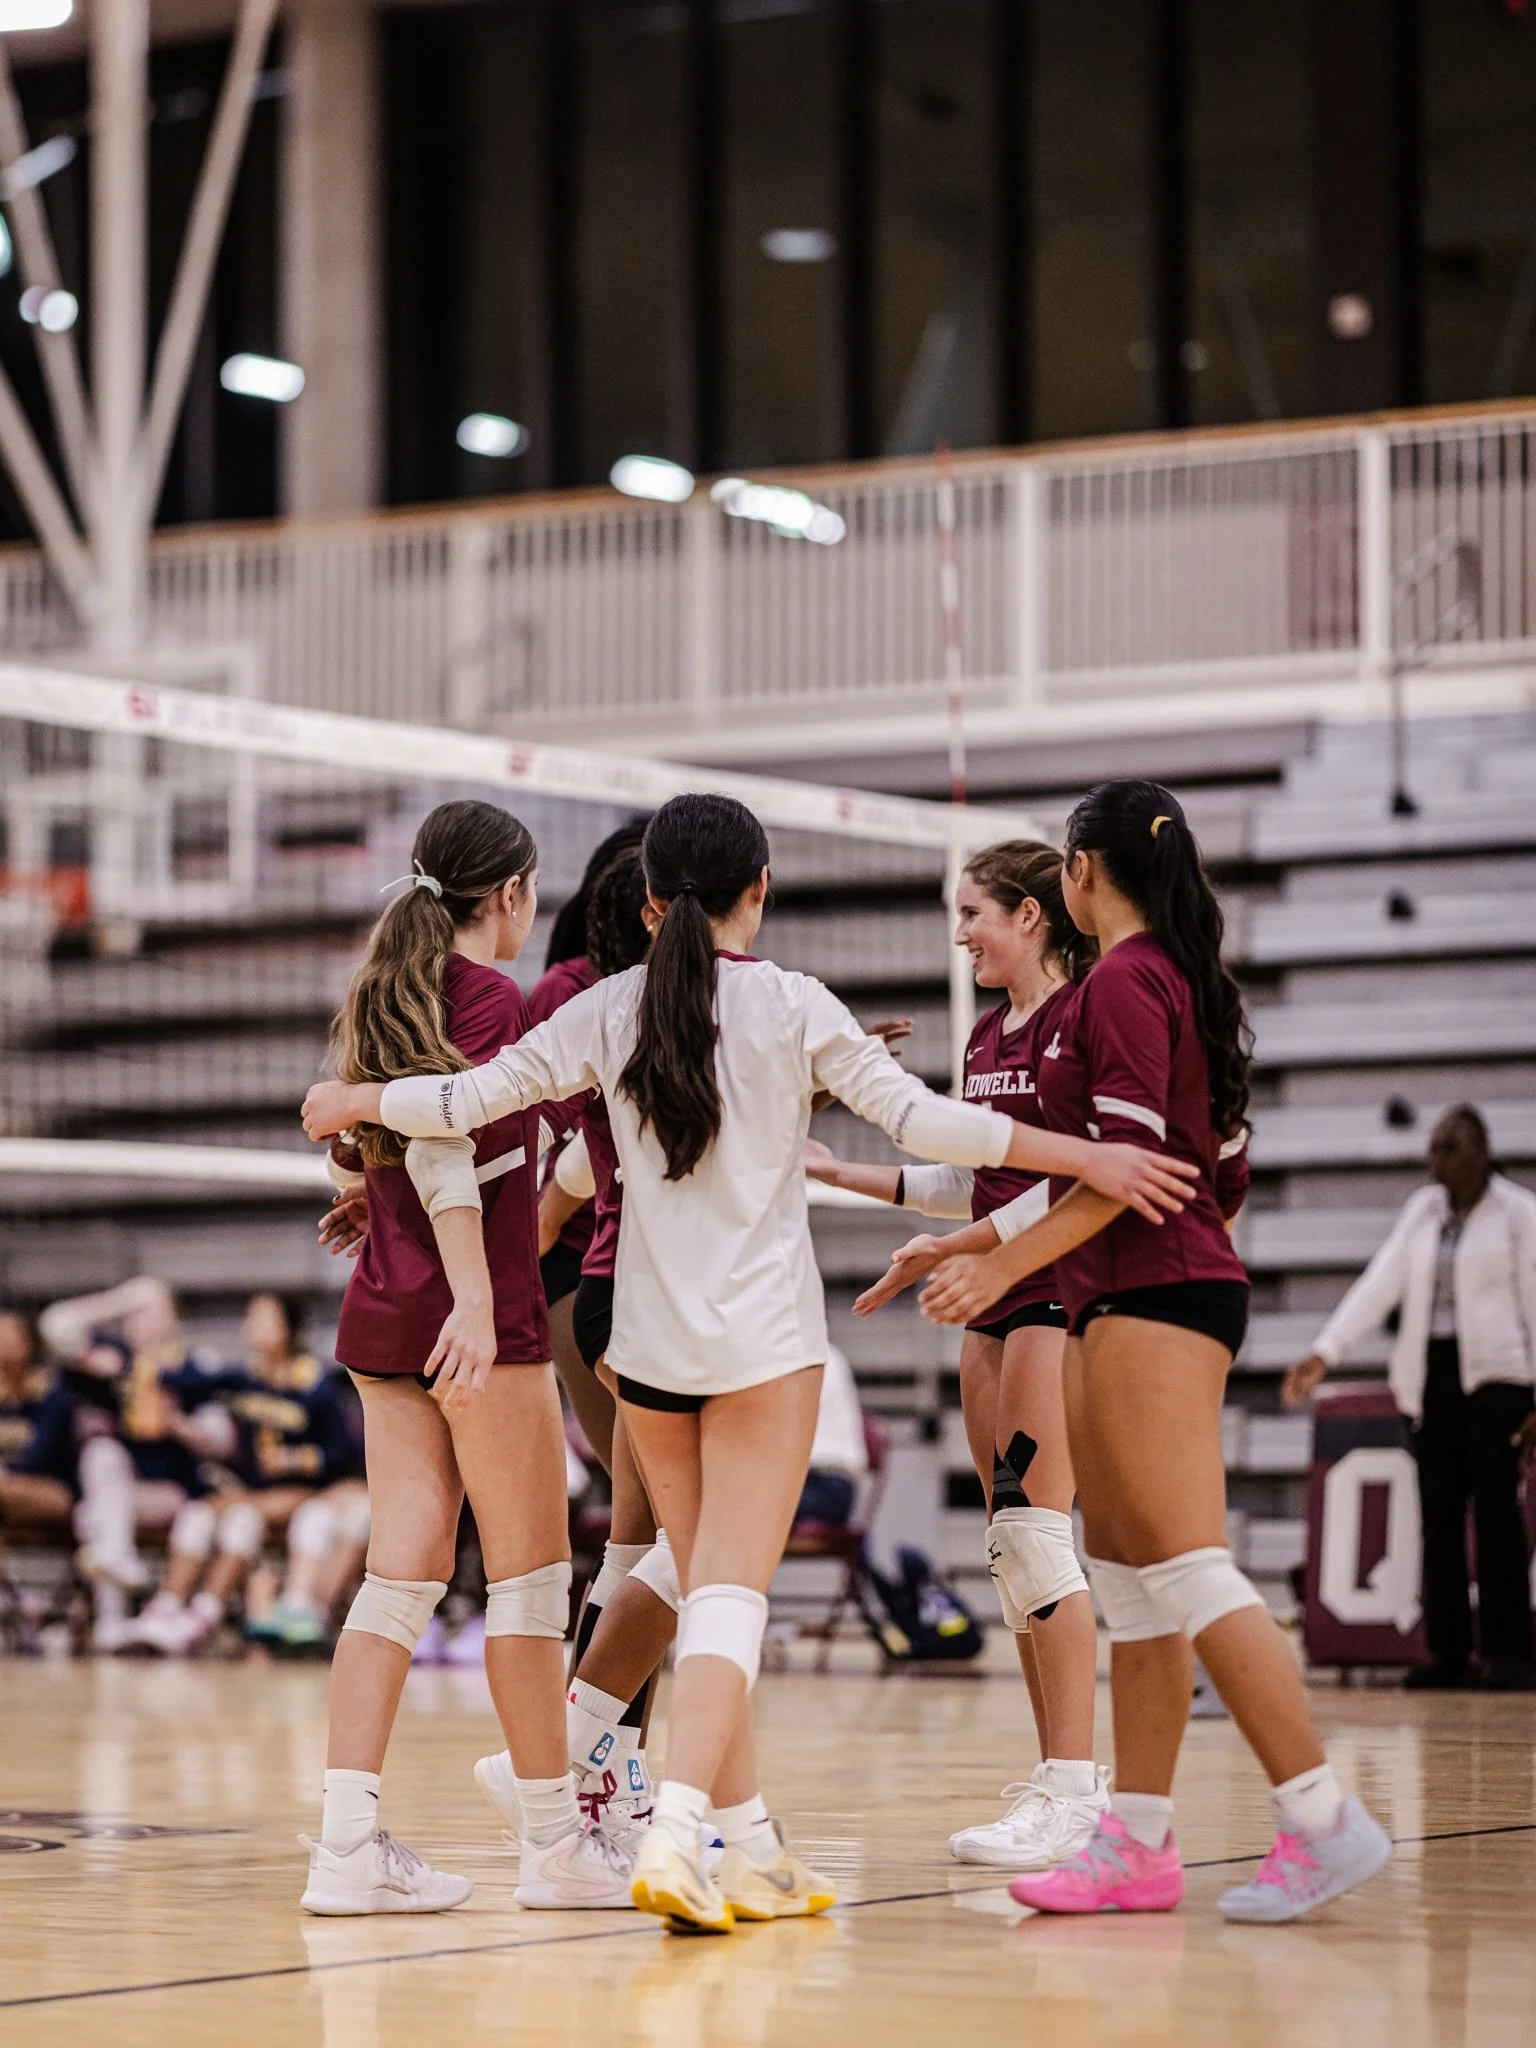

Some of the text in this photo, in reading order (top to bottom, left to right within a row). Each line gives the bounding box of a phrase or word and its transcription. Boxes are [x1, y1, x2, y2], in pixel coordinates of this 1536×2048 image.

[439, 1080, 455, 1129] Tandem
[965, 1070, 1036, 1099] IDWELL
[1319, 1447, 1425, 1636] Q
